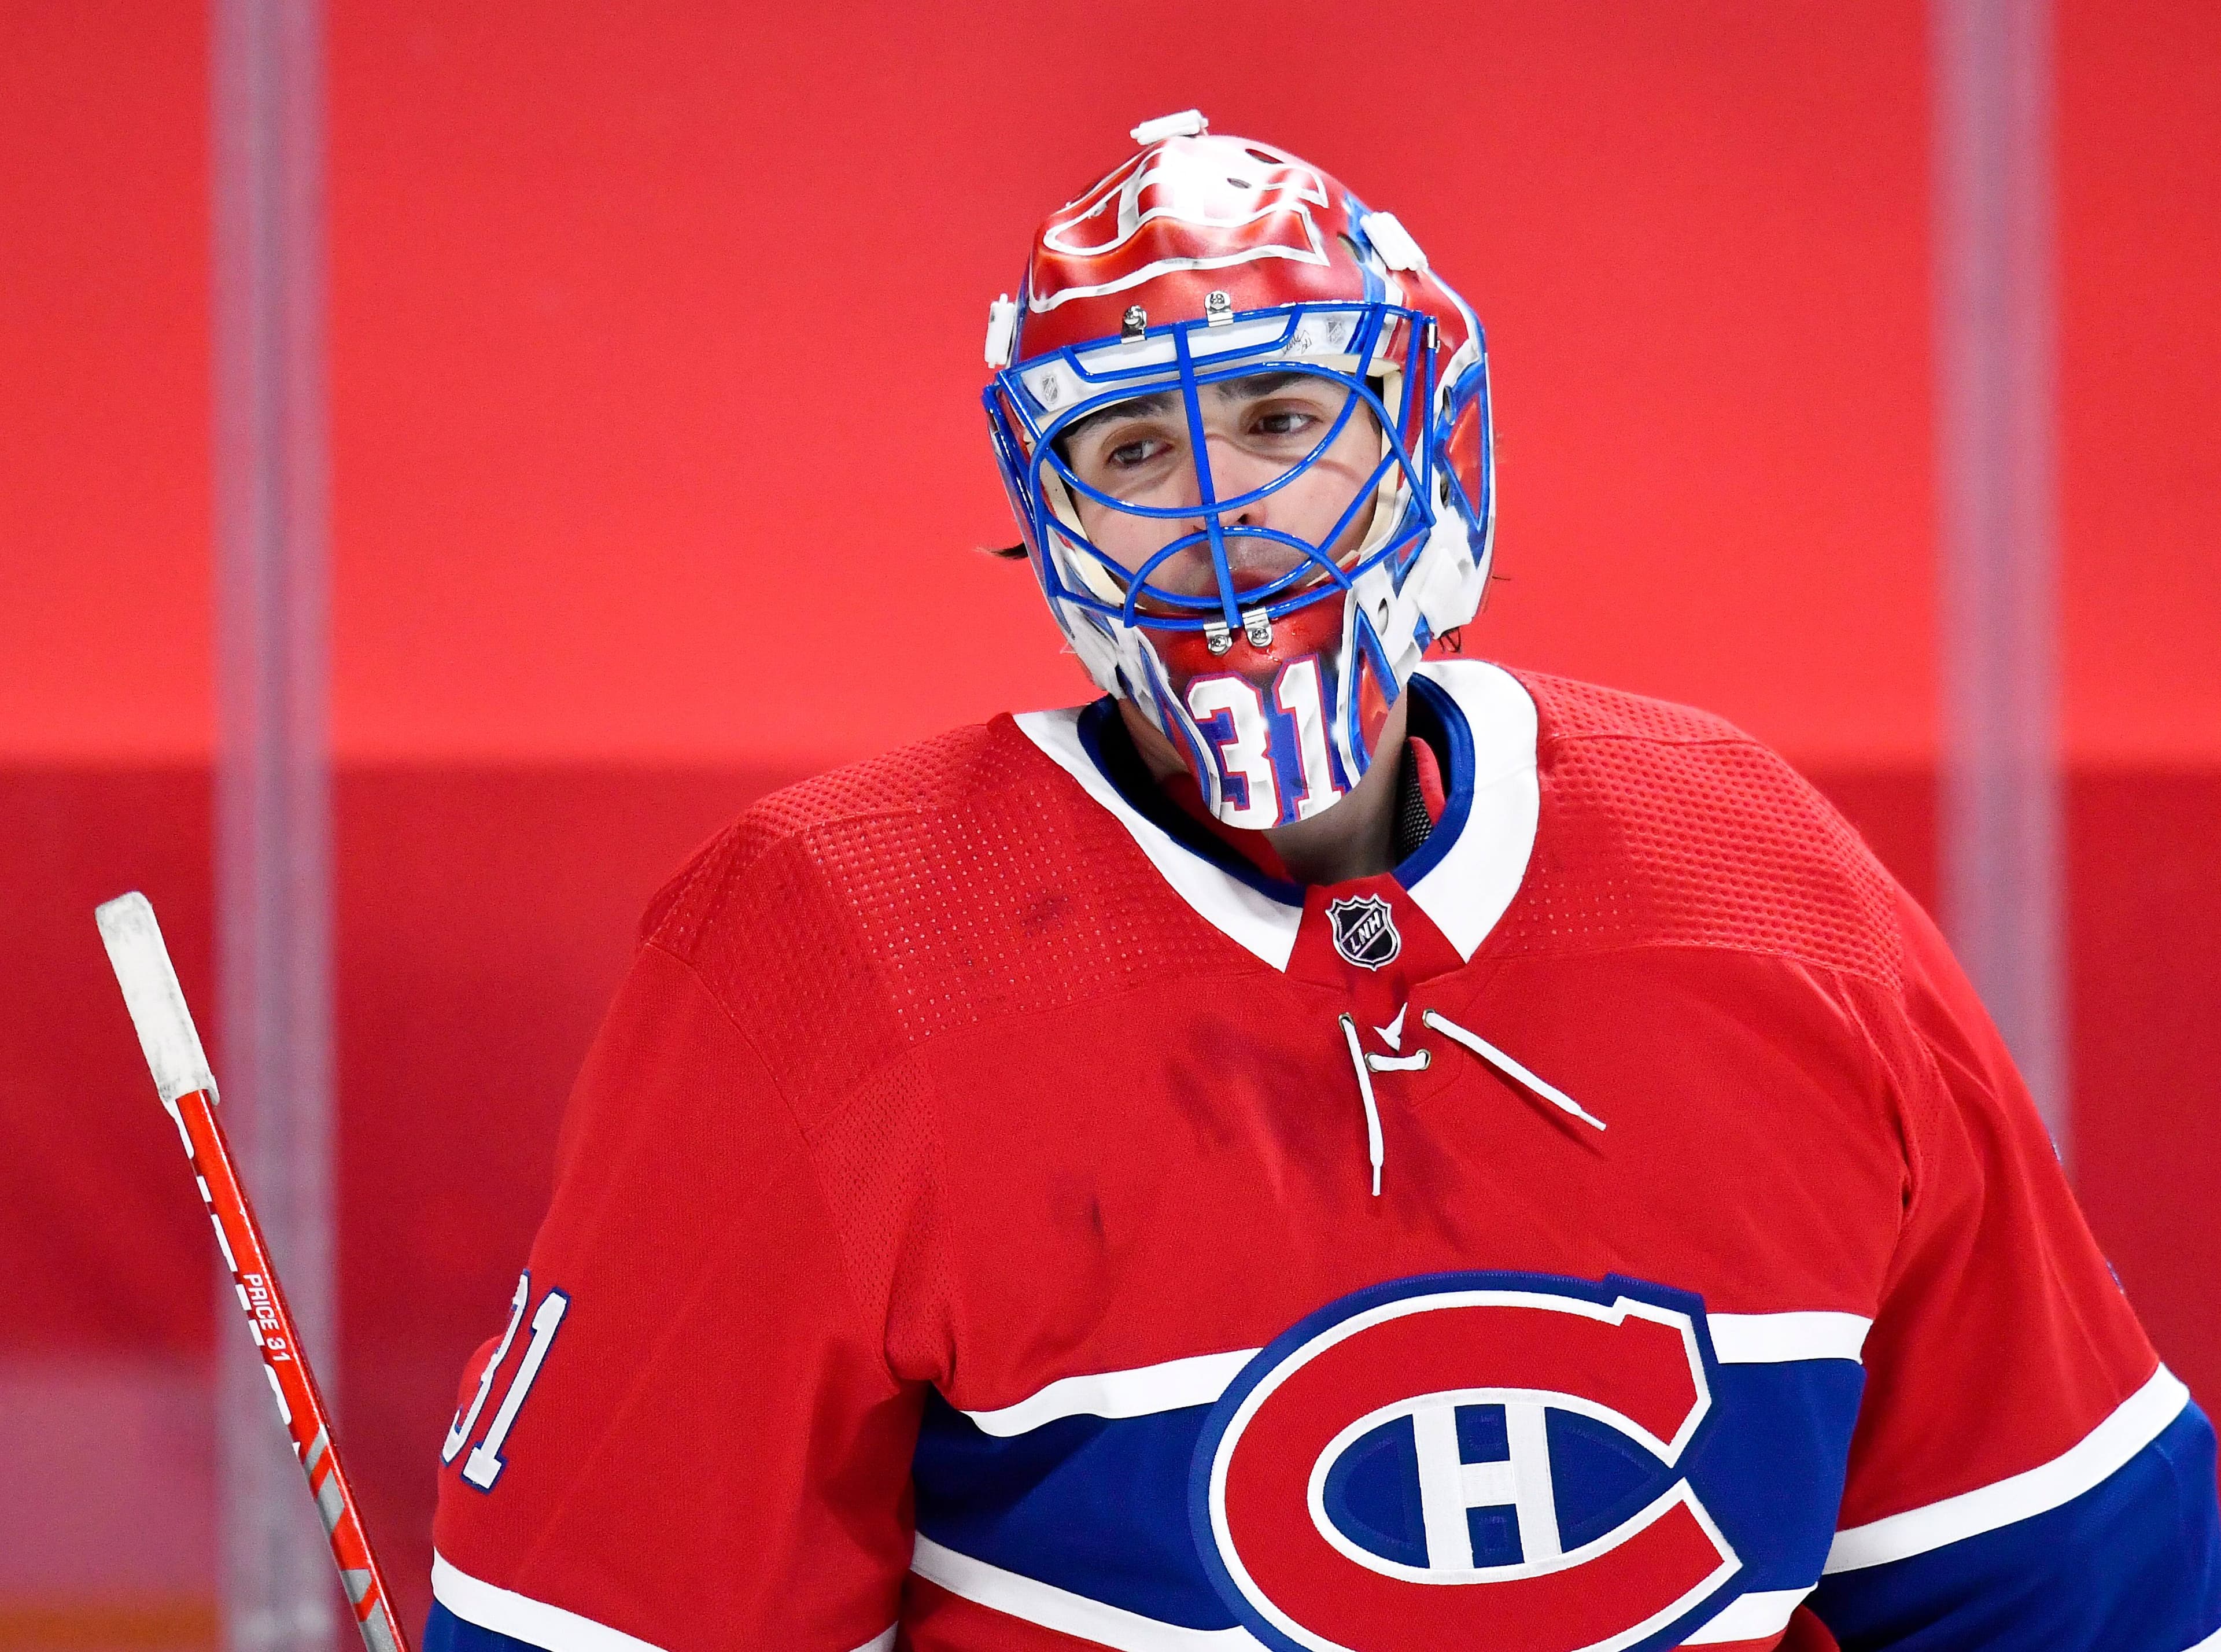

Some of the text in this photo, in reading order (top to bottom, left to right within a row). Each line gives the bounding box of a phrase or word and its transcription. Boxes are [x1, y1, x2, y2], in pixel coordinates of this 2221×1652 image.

[1186, 654, 1343, 830] 31
[1349, 910, 1381, 953] LNH
[242, 1274, 280, 1330] PRICE
[266, 1337, 292, 1361] 31
